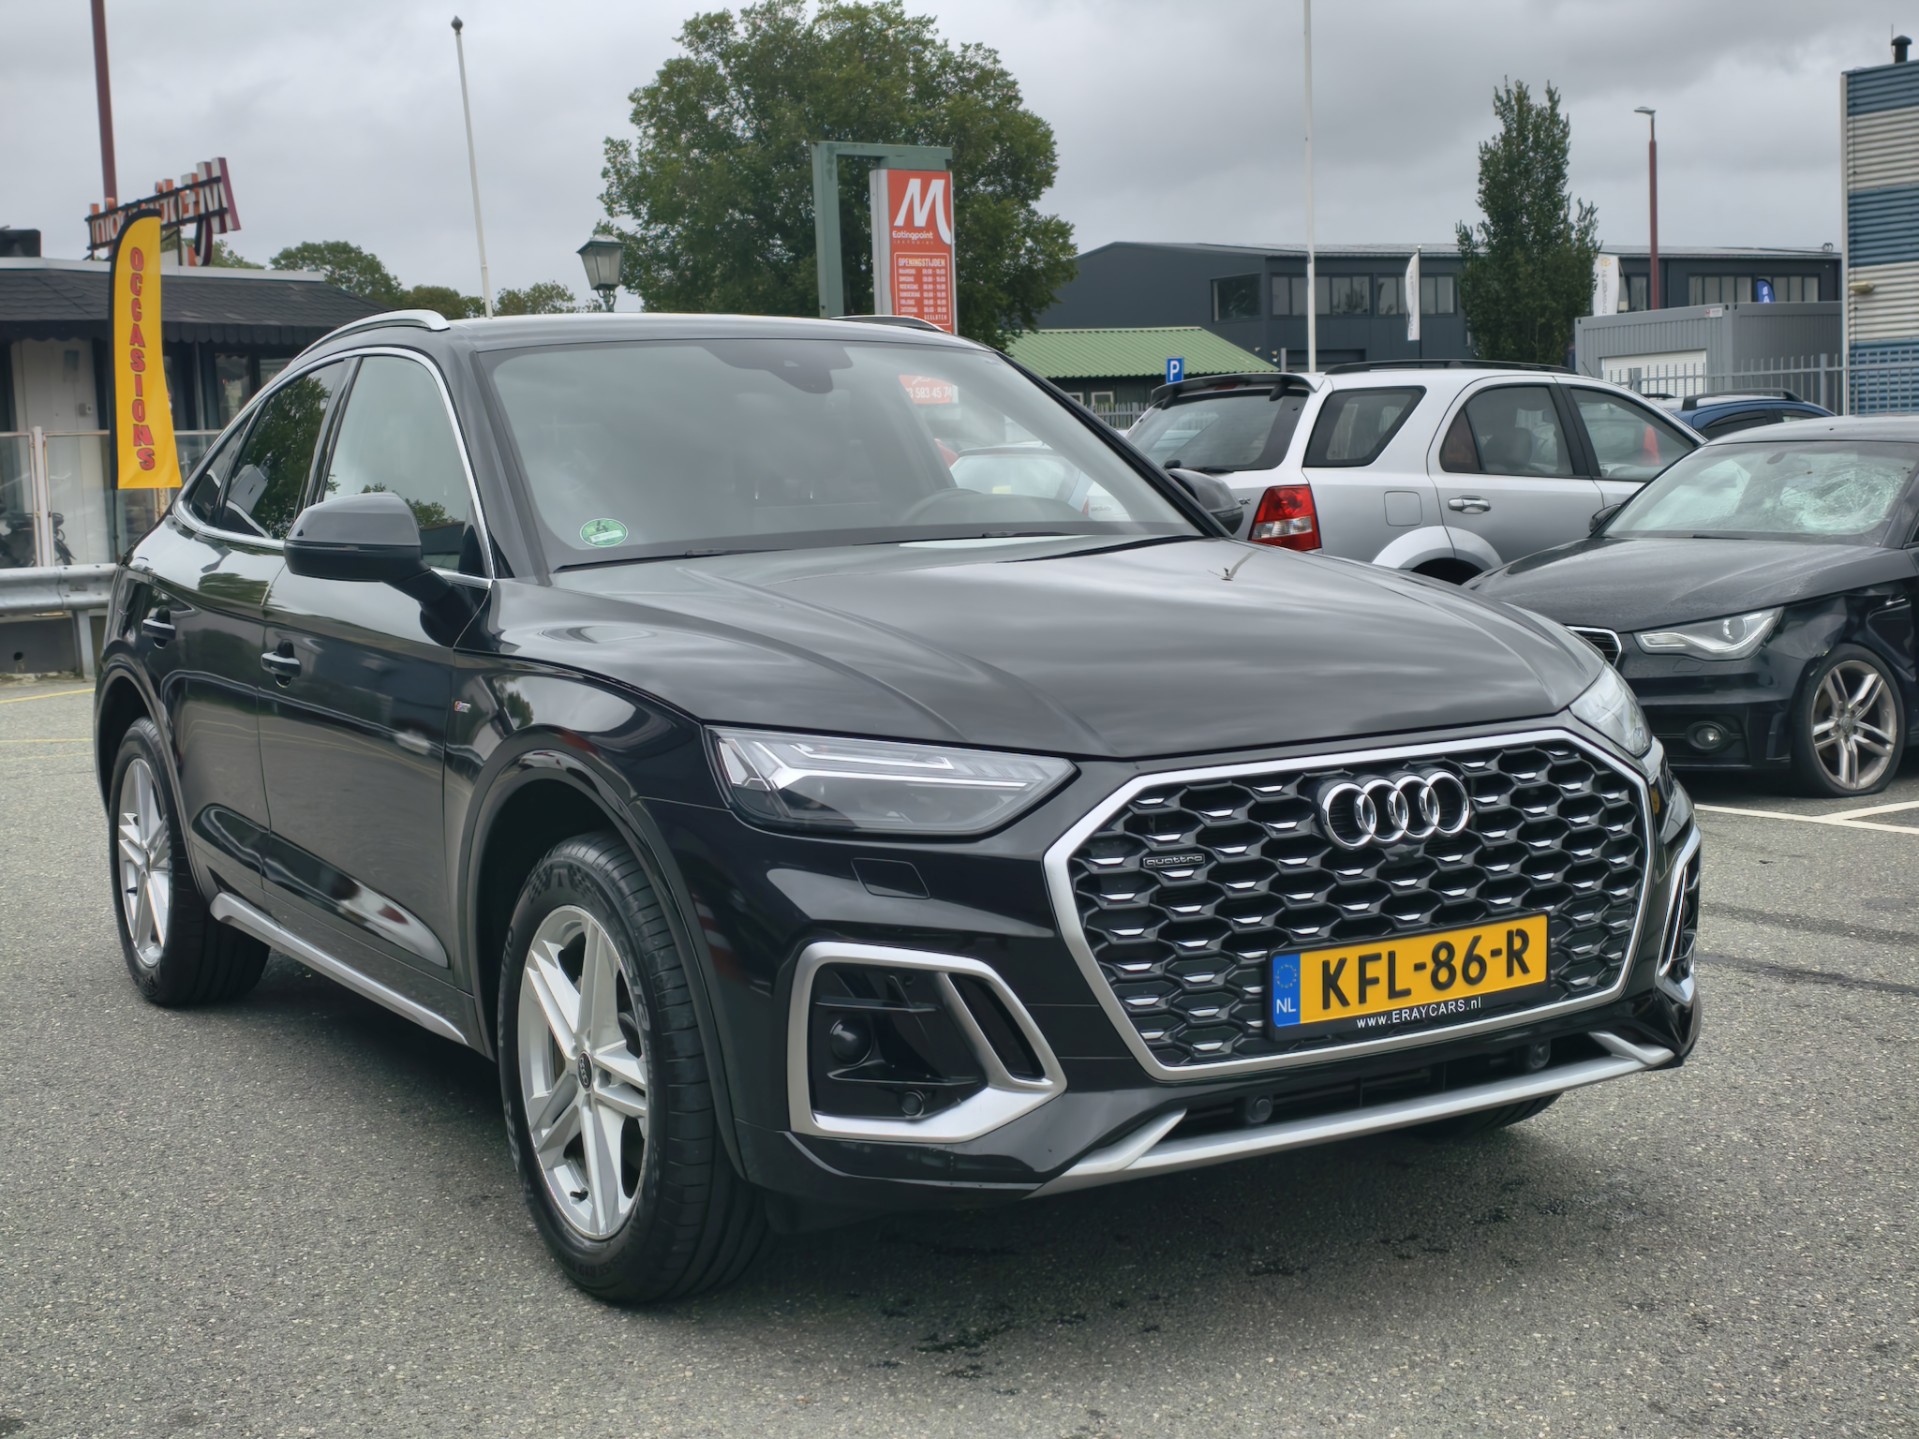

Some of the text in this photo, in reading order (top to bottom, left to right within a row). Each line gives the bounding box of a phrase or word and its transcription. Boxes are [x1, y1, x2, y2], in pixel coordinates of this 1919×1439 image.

[894, 178, 951, 245] M
[892, 230, 934, 241] Eatingpoint
[129, 246, 156, 471] OCCASIONS
[1170, 360, 1180, 381] P
[1146, 855, 1203, 867] quattro
[1322, 928, 1530, 1010] KFL-86-R
[1276, 998, 1296, 1014] NL
[1356, 996, 1482, 1028] www.ERAYCARS.nl
